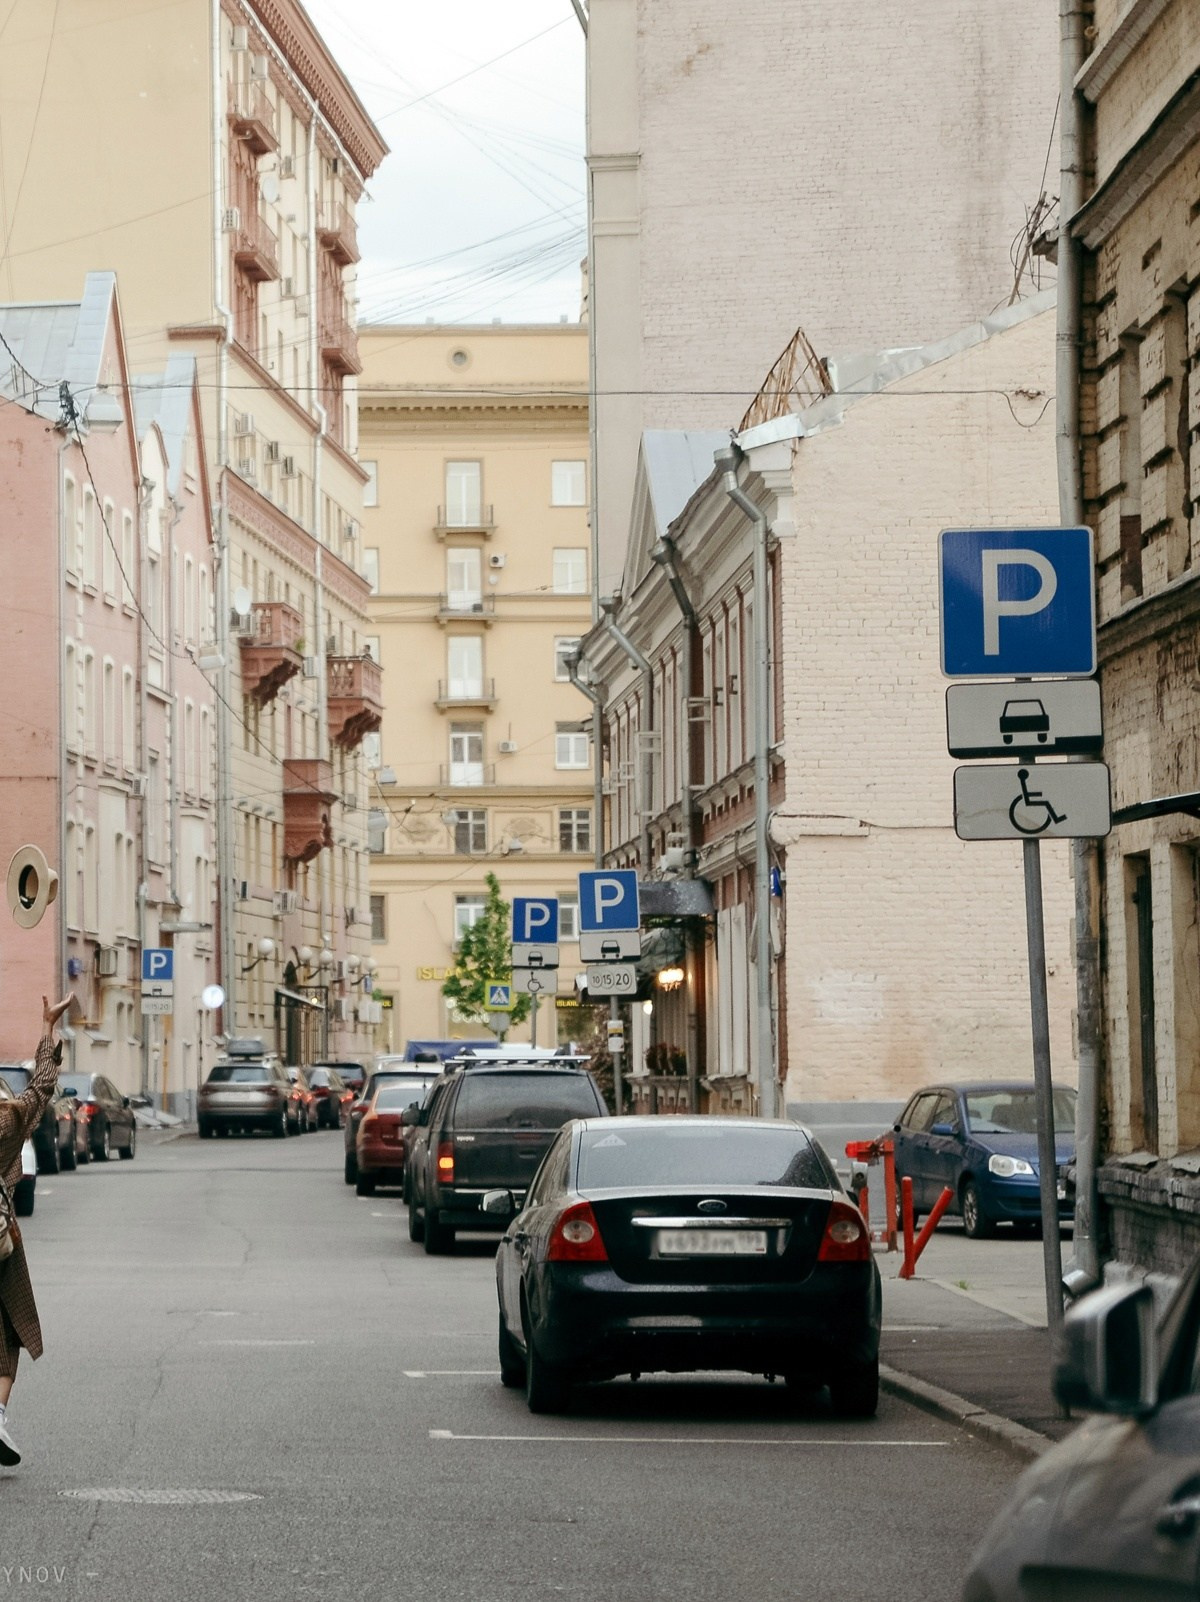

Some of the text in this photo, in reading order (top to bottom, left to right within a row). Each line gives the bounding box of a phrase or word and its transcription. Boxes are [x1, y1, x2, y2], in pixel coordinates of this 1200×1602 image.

[982, 549, 1057, 655] P
[594, 878, 624, 923] P
[524, 902, 550, 939] P
[150, 952, 167, 976] P
[592, 973, 630, 985] 10 15 20
